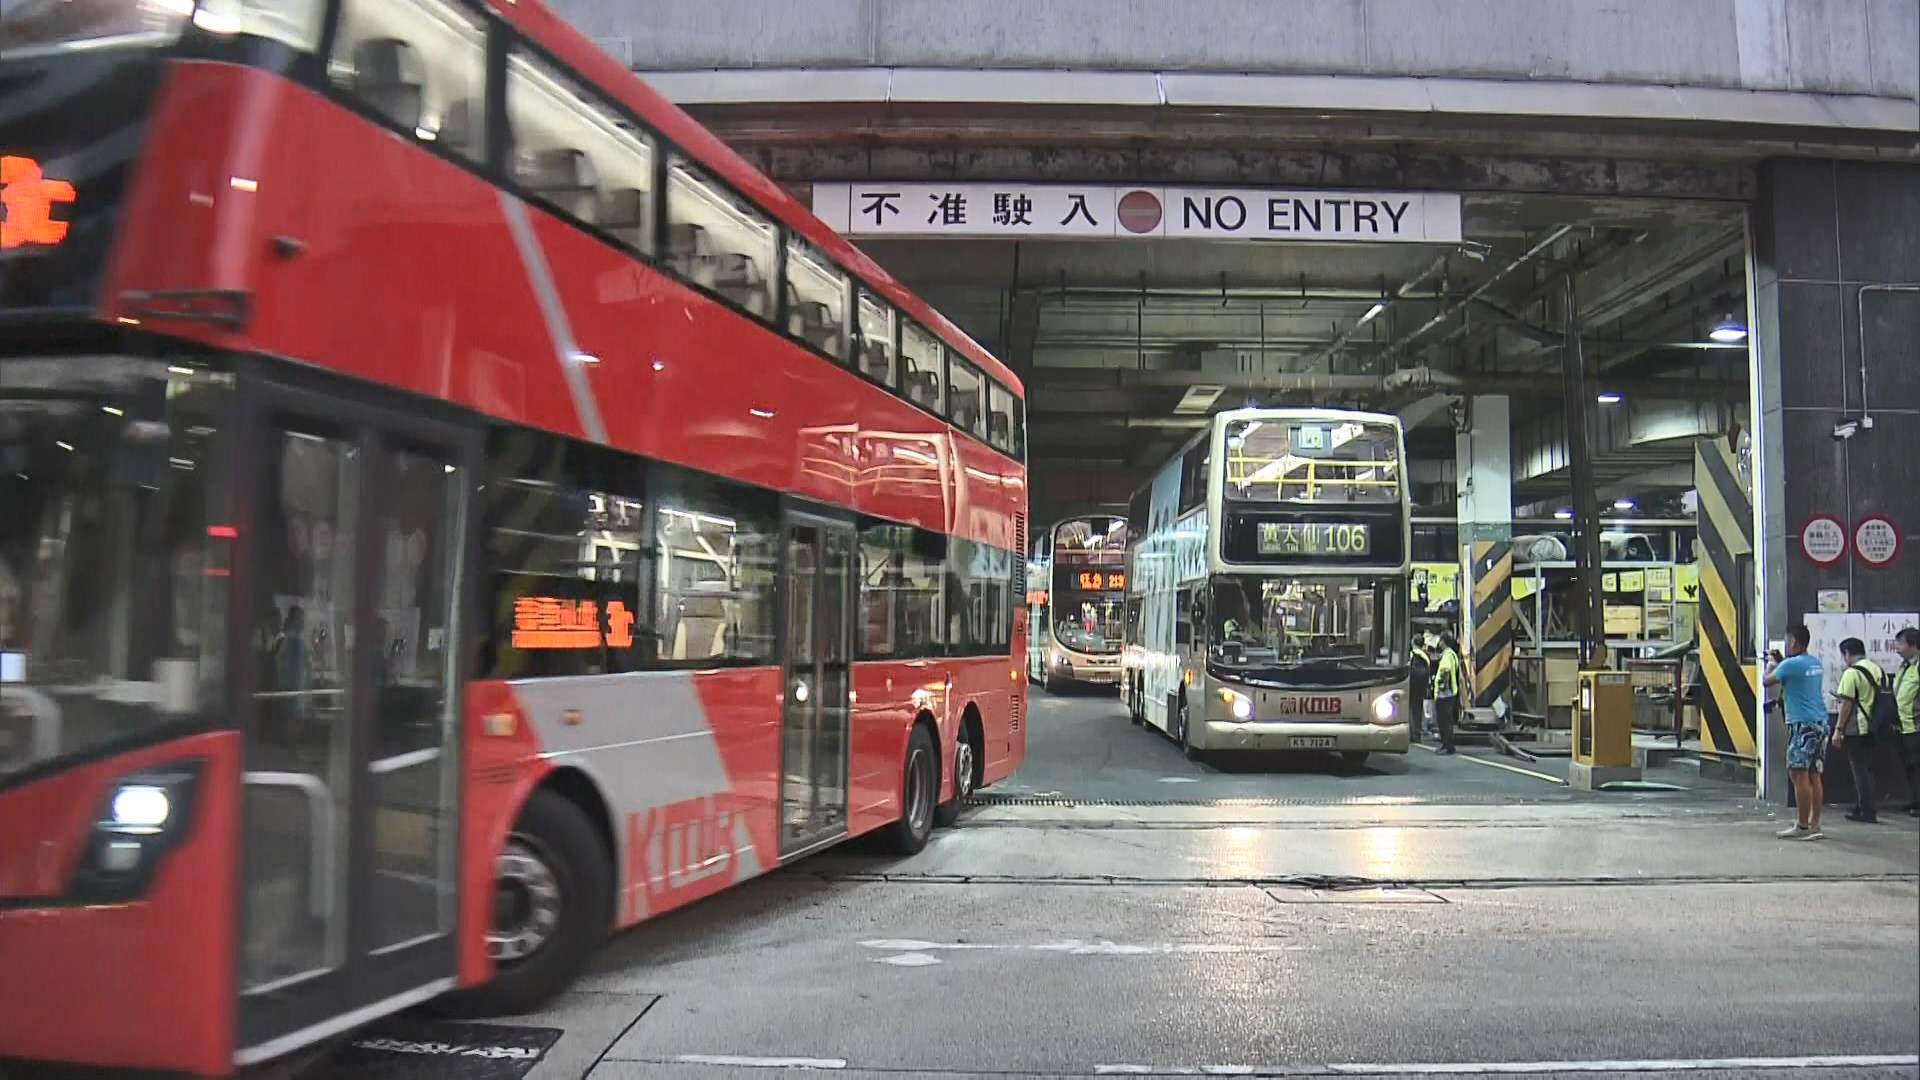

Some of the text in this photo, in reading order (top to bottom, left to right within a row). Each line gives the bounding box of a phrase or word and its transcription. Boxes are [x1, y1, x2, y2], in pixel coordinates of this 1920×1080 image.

[861, 193, 1098, 226] 不准駛入
[1183, 196, 1410, 234] NO ENTRY
[1324, 523, 1366, 552] 106
[1299, 696, 1342, 715] KMB
